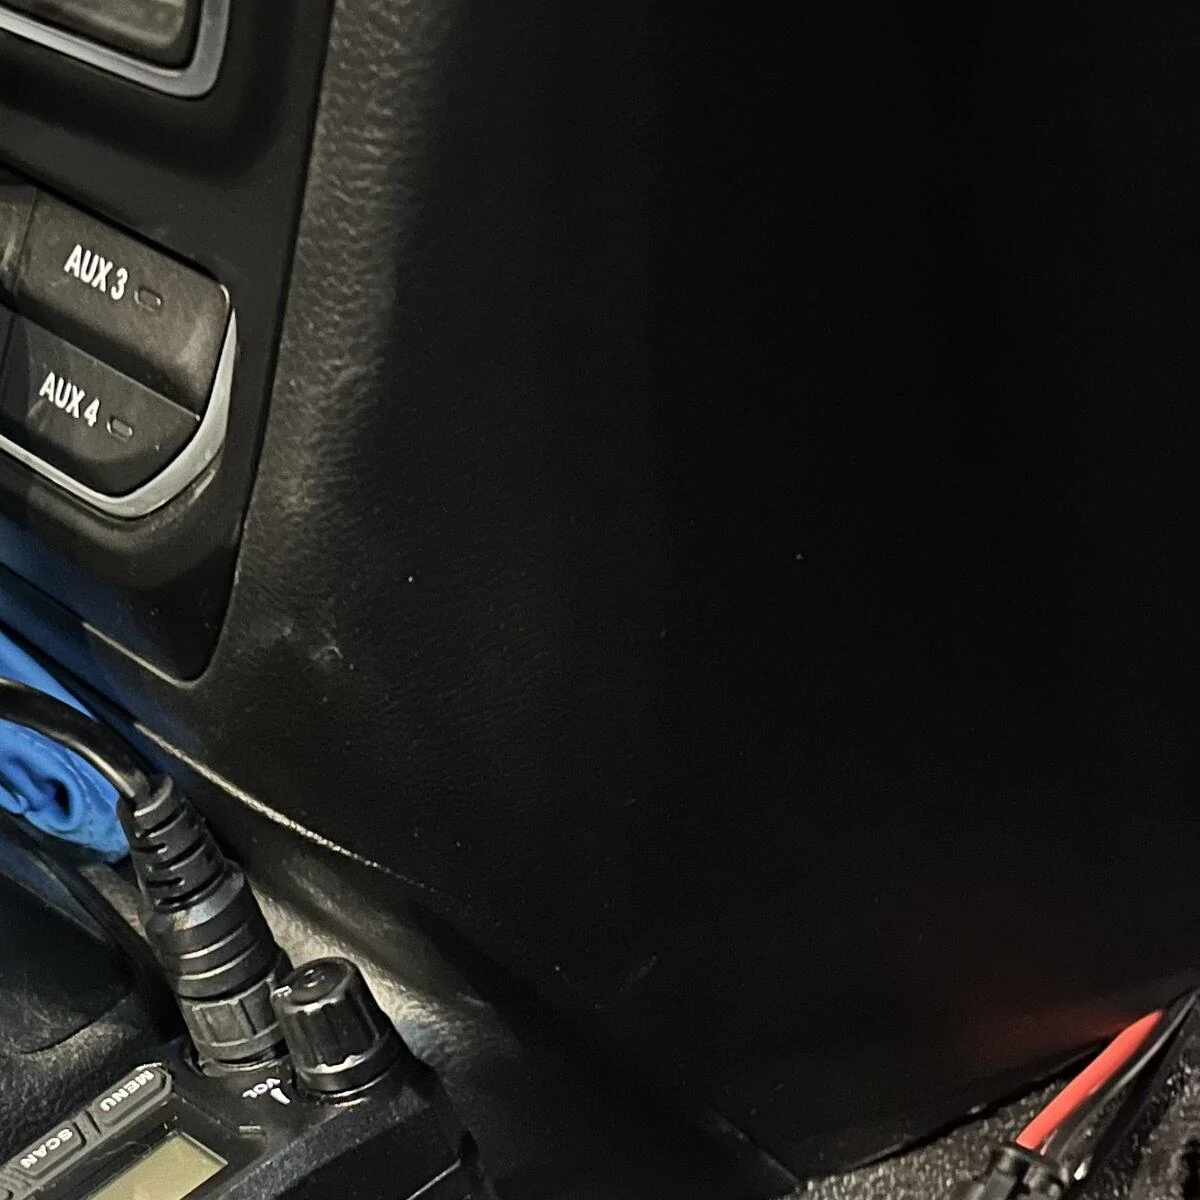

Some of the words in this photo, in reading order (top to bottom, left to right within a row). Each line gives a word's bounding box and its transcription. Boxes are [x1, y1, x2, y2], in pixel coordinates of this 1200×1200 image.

[63, 244, 113, 293] AUX
[110, 267, 128, 300] 3
[39, 371, 85, 419] AUX
[83, 398, 99, 427] 4
[100, 1069, 156, 1112] MENU
[242, 1077, 281, 1100] VOL
[20, 1127, 74, 1169] SCAN
